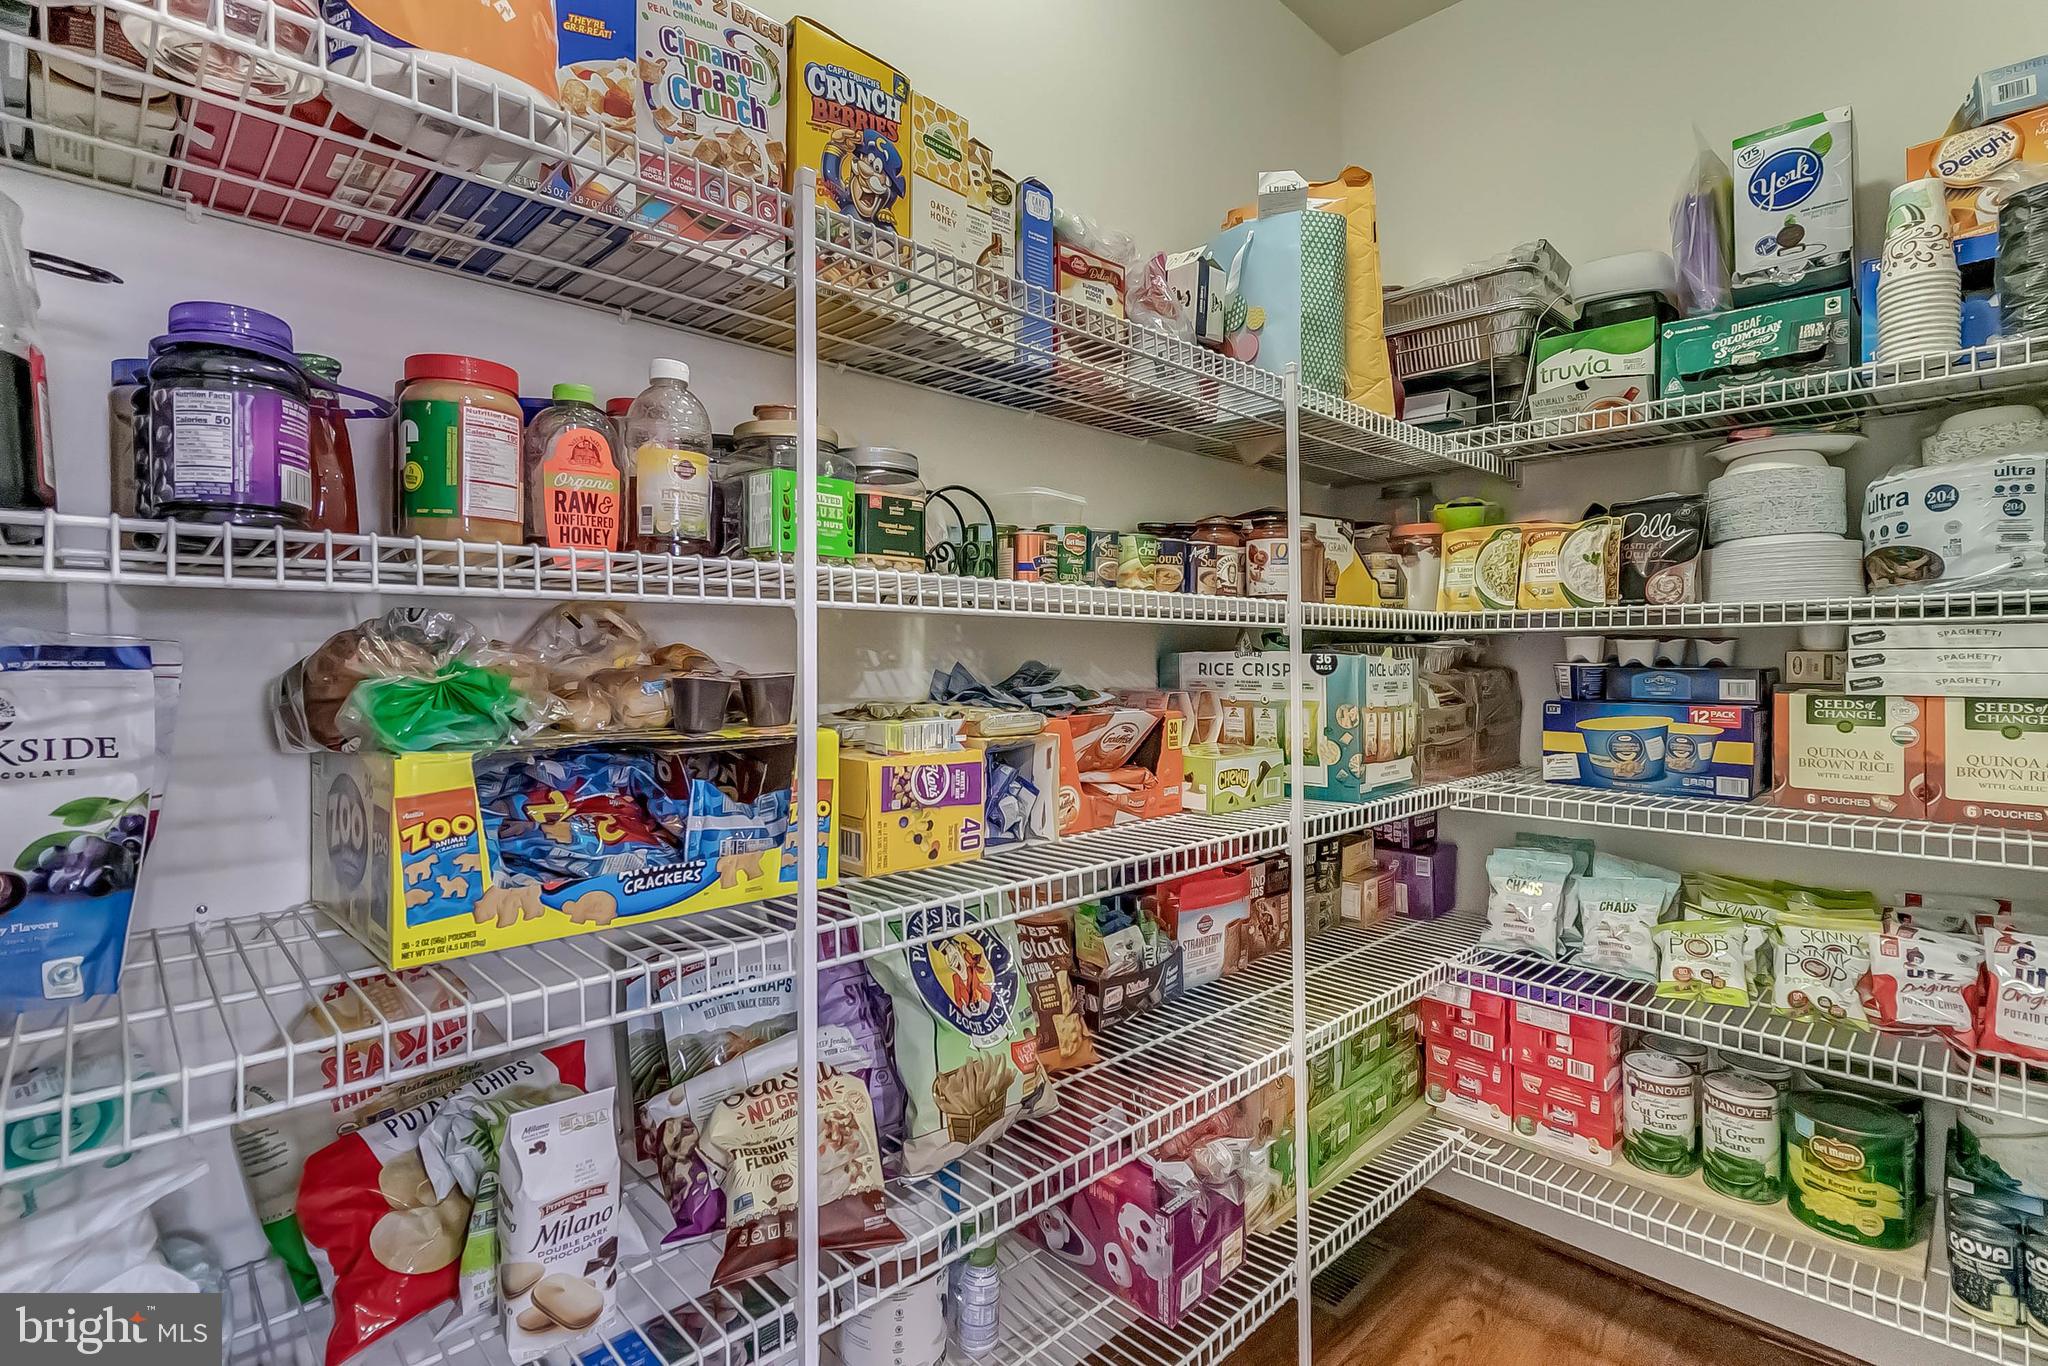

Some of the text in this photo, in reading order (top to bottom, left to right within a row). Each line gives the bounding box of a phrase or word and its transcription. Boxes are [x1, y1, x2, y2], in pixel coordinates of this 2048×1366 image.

[568, 13, 605, 29] THEY'RE
[647, 3, 719, 31] REAL CINNAMON
[731, 2, 784, 47] BAGS!
[660, 26, 767, 84] Cinnamon
[683, 58, 750, 98] Toast
[805, 64, 901, 123] CRUNCH
[668, 74, 769, 133] Crunch
[811, 96, 899, 141] BERRIES
[1740, 147, 1760, 162] 175
[1937, 130, 2016, 177] Delight
[1751, 155, 1819, 211] York
[929, 199, 949, 216] OATS
[929, 210, 957, 229] HONEY
[1730, 315, 1762, 335] DECAF
[1712, 320, 1783, 350] COLOMBIAN
[1532, 391, 1589, 408] NATURALLY SWEET
[176, 416, 231, 426] Calories 50
[1992, 464, 2036, 478] ultra
[554, 472, 615, 490] Organic
[554, 490, 613, 514] RAW &
[1867, 489, 1909, 517] ultra
[1926, 489, 1959, 508] 204
[2003, 500, 2027, 514] 204
[554, 513, 614, 529] UNFILTERED
[1621, 512, 1696, 541] Della
[560, 526, 611, 546] HONEY
[1936, 628, 2002, 638] SPAGHETTI
[1936, 653, 2002, 662] SPAGHETTI
[1198, 663, 1234, 676] RICE
[1369, 663, 1412, 677] RICE CRISPS
[1935, 677, 2001, 687] SPAGHETTI
[1814, 699, 1877, 711] SEEDS of
[1974, 702, 2034, 715] SEEDS
[1690, 710, 1736, 724] 12 PACK
[1814, 710, 1880, 721] CHANGE
[1169, 722, 1178, 734] 30
[1807, 746, 1884, 761] QUINOA &
[1966, 754, 2041, 770] QUINOA
[1798, 757, 1895, 774] BROWN RICE
[1956, 766, 2024, 781] BROWN
[1817, 772, 1874, 782] WITH GARLIC
[1978, 781, 2046, 793] WITH GARLIC
[1807, 794, 1871, 807] 6 POUCHES
[329, 793, 367, 851] ZOO
[1967, 807, 2043, 821] 6 POUCHES
[400, 815, 477, 854] ZOO
[435, 836, 467, 849] ANIMAL
[960, 817, 982, 852] 40
[623, 867, 702, 895] CRACKERS
[1715, 901, 1769, 919] SKINNY
[11, 920, 59, 932] Flavors
[448, 930, 478, 943] POUCHES
[1182, 932, 1222, 952] STRAWBERRY
[1800, 929, 1863, 944] SKINNY
[401, 942, 411, 950] 36
[401, 949, 427, 961] NET WT
[428, 947, 438, 956] 72
[1668, 937, 1729, 959] POP
[1788, 946, 1852, 968] SKINNY
[1784, 953, 1848, 987] POP
[1906, 968, 1955, 981] utz
[738, 999, 757, 1011] SNACK
[2003, 1008, 2044, 1025] POTATO
[471, 1058, 535, 1096] CHIPS
[1639, 1080, 1692, 1096] HANOVER
[747, 1097, 774, 1124] NO
[1631, 1101, 1689, 1122] Cut Green
[1710, 1098, 1772, 1119] HANOVER
[523, 1122, 550, 1138] Milano
[1643, 1115, 1679, 1131] Beans
[1704, 1117, 1766, 1146] Cut Green
[730, 1136, 796, 1158] TIGERNUT
[1714, 1132, 1753, 1155] Beans
[1813, 1140, 1861, 1163] Del Monte
[745, 1152, 789, 1173] FLOUR
[1804, 1167, 1878, 1197] Whole Kernel Corn
[528, 1204, 615, 1254] Milano
[537, 1227, 609, 1259] DOUBLE DARK
[543, 1236, 605, 1265] CHOCOLATE
[1949, 1231, 2010, 1265] GOYA
